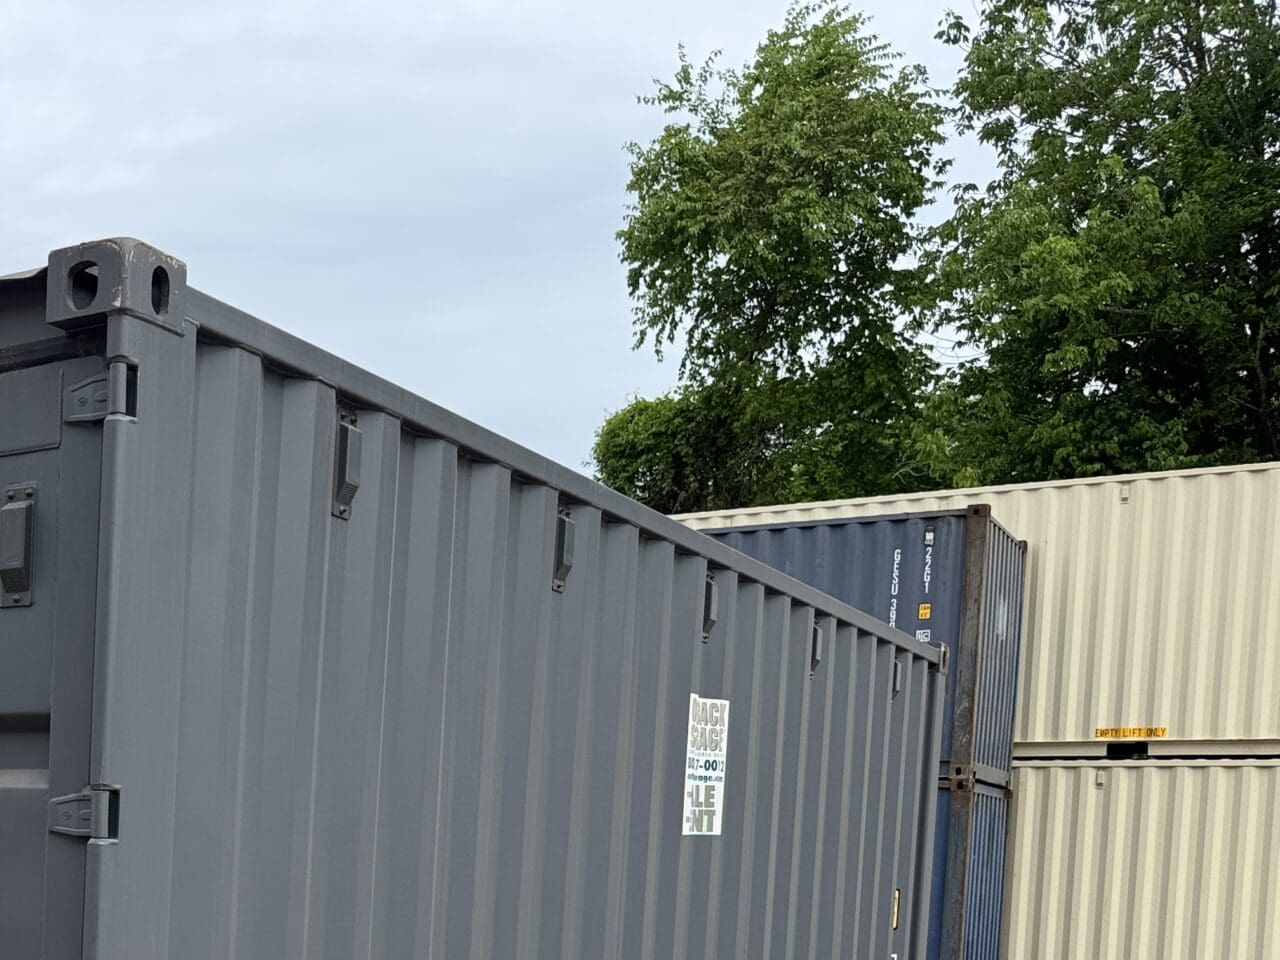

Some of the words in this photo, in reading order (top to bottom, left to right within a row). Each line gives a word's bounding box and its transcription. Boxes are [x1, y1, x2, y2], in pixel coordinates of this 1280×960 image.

[1095, 728, 1120, 738] EMPTY
[1122, 728, 1142, 737] LIFT
[1146, 727, 1167, 737] ONLY
